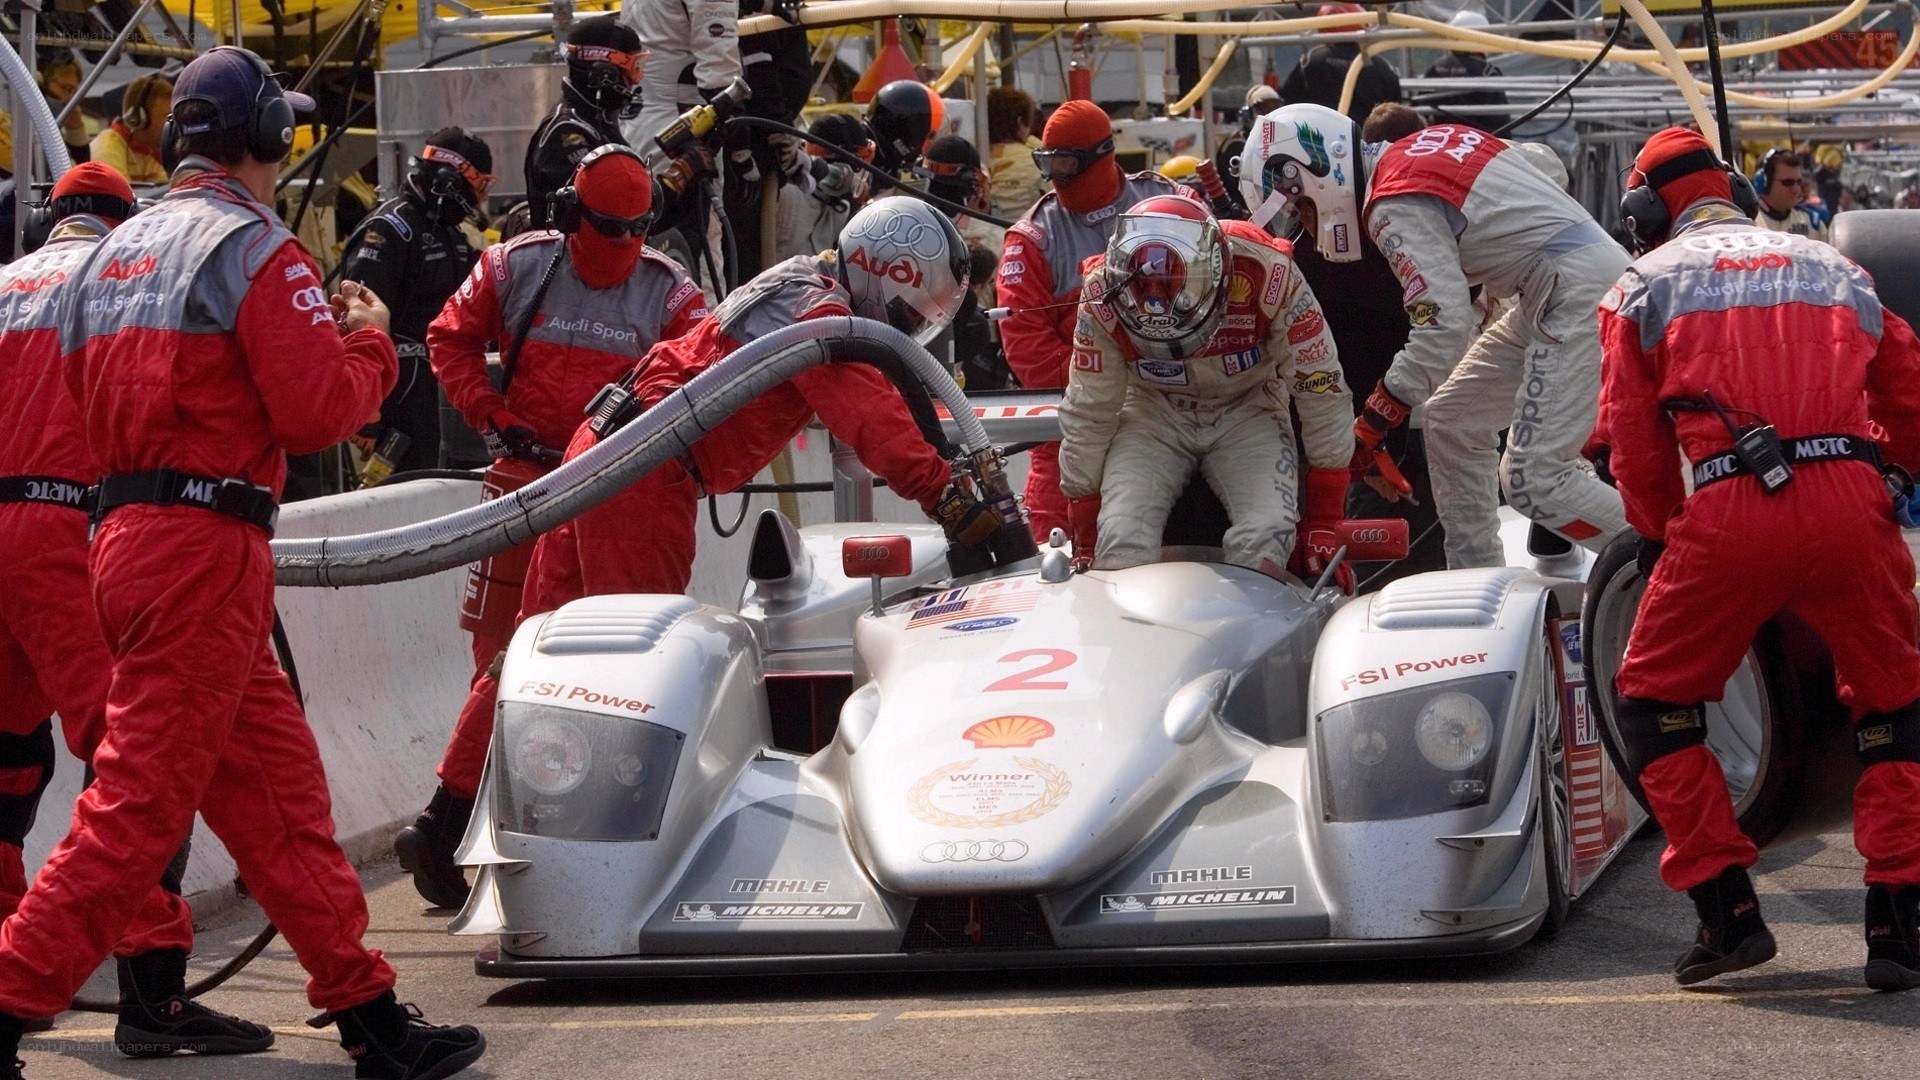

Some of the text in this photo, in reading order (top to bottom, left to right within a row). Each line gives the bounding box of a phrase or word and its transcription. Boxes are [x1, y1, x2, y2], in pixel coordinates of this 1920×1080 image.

[1856, 39, 1897, 67] 45
[1262, 122, 1270, 160] UNIPART
[1444, 130, 1485, 163] Audi
[98, 254, 158, 282] Audi
[847, 245, 924, 289] Audi
[1714, 252, 1793, 272] Audi
[666, 283, 694, 310] sparco
[1265, 264, 1282, 304] sparco
[1693, 279, 1823, 298] Audi Service
[549, 315, 638, 344] Audi Sport
[1144, 315, 1173, 326] Arai
[1228, 316, 1257, 326] BOSCH
[1297, 370, 1341, 391] SUNOCO
[1795, 437, 1852, 460] MRTC
[1694, 453, 1739, 485] MRTC
[1273, 481, 1297, 550] Audi
[981, 647, 1078, 692] 2
[1340, 651, 1488, 691] FSI Power
[518, 681, 656, 714] FSI Power
[949, 773, 1034, 782] Winner
[729, 877, 831, 893] MAHLE
[1151, 865, 1252, 885] MAHLE
[721, 904, 853, 916] MICHELIN
[1150, 890, 1287, 906] MICHELIN
